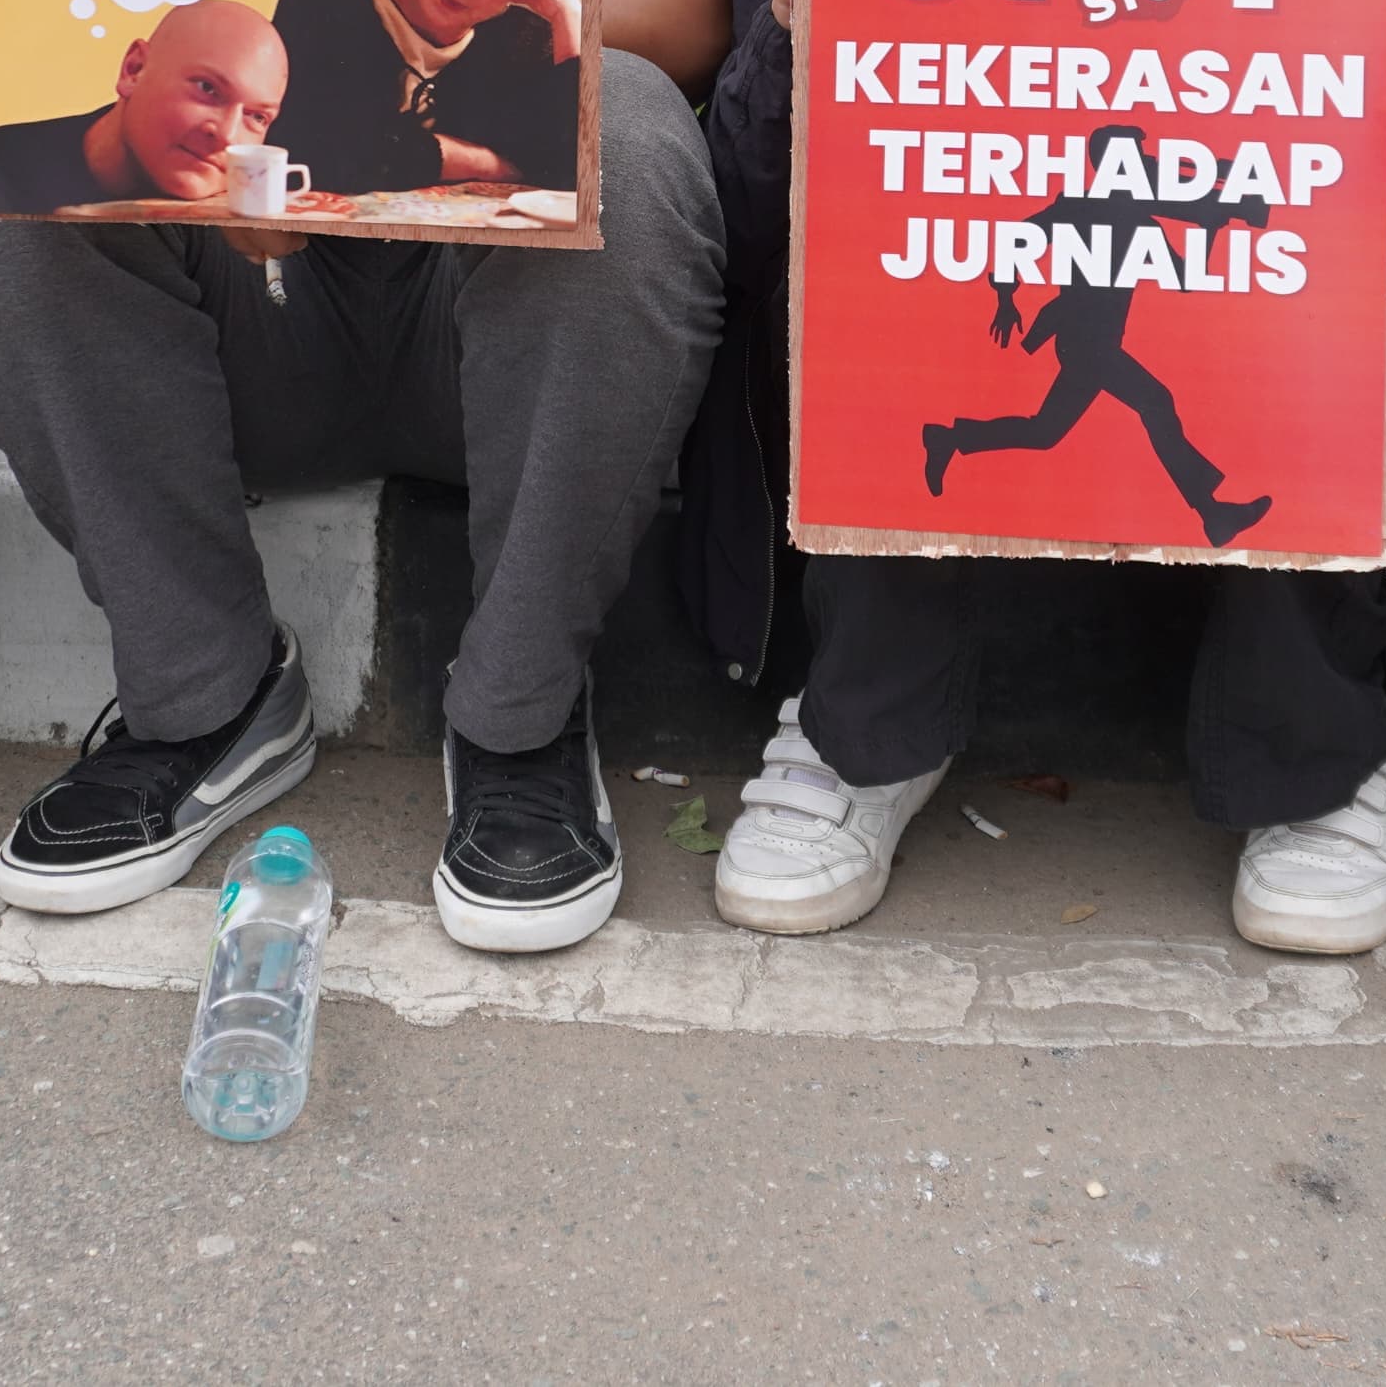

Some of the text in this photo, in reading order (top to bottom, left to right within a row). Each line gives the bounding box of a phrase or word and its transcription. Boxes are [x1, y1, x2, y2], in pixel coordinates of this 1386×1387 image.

[835, 41, 1365, 119] KEKERASAN
[869, 129, 1344, 206] TERHADAP
[880, 217, 1308, 295] JURNALIS
